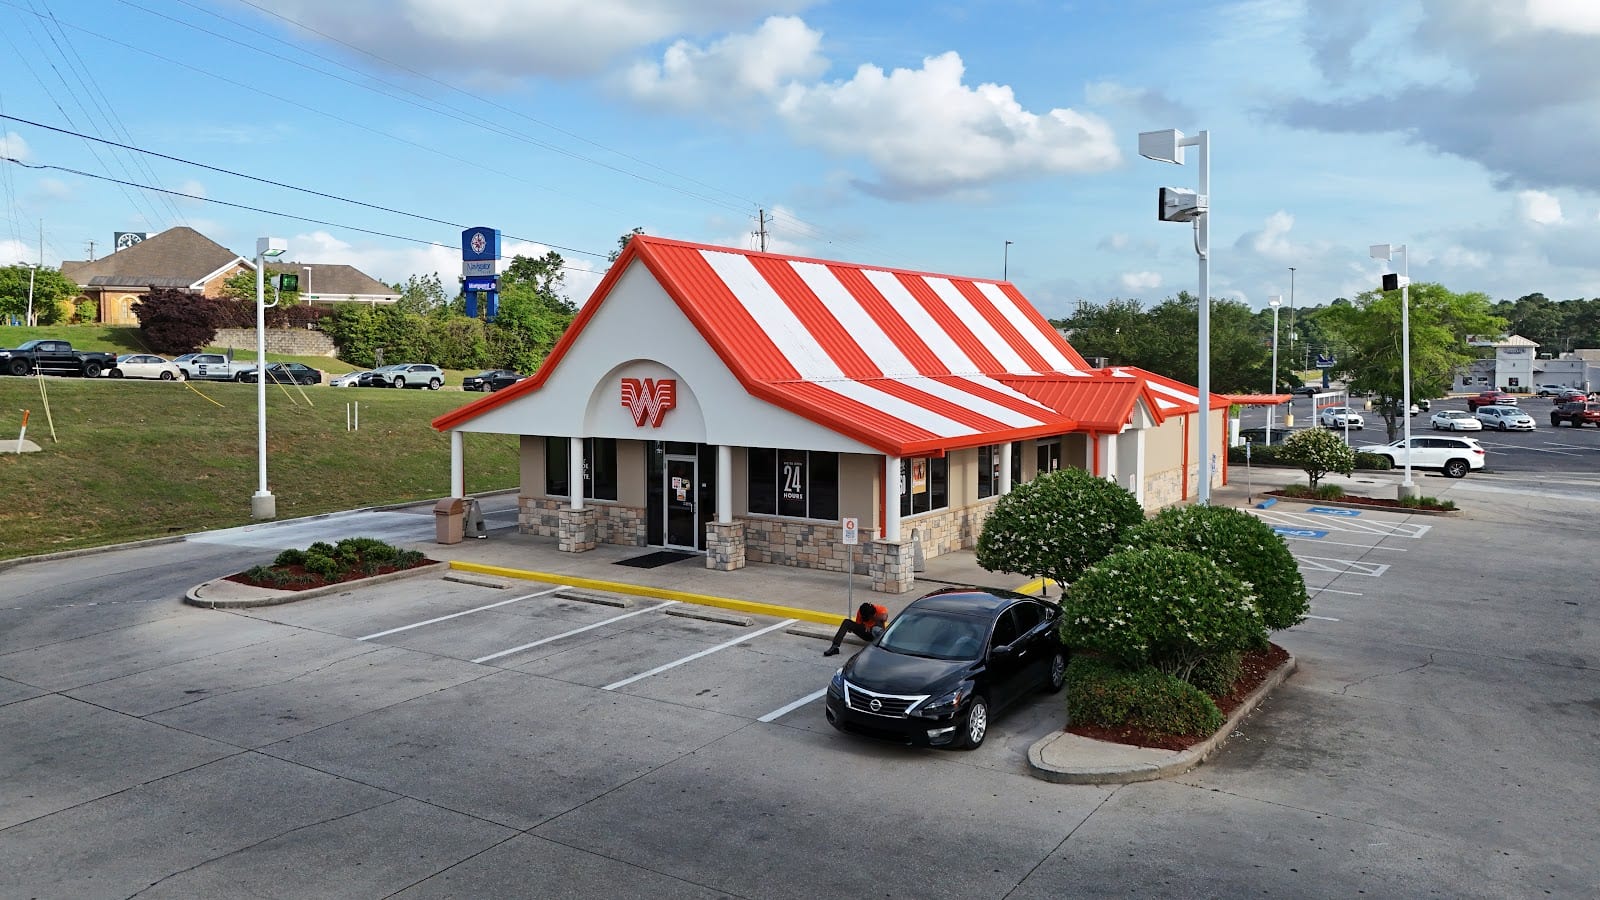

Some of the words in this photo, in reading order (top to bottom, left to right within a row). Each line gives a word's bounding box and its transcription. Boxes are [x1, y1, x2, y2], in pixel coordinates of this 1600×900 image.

[621, 377, 677, 428] W
[783, 465, 802, 493] 24
[783, 492, 803, 500] HOURS
